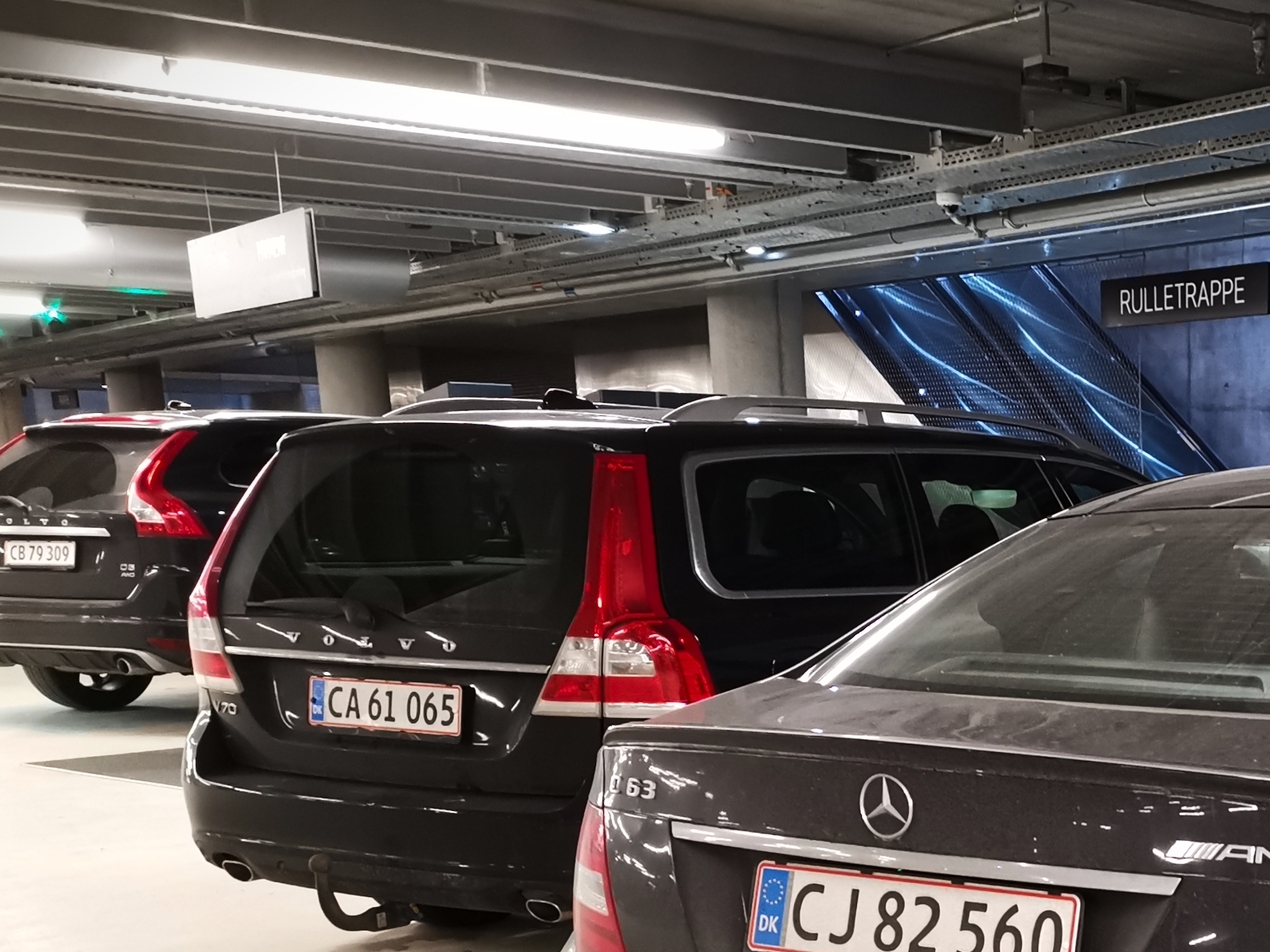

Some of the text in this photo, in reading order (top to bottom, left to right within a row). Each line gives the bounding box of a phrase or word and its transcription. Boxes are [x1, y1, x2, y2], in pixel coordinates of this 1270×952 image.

[1120, 276, 1245, 315] RULLETRAPPE
[10, 545, 69, 562] CB 79 309
[287, 631, 457, 652] VOLVO
[212, 700, 237, 715] V70
[312, 704, 323, 715] DK
[328, 686, 455, 726] CA 61 065
[626, 777, 657, 800] 63
[758, 914, 778, 935] DK
[792, 883, 860, 945] CJ
